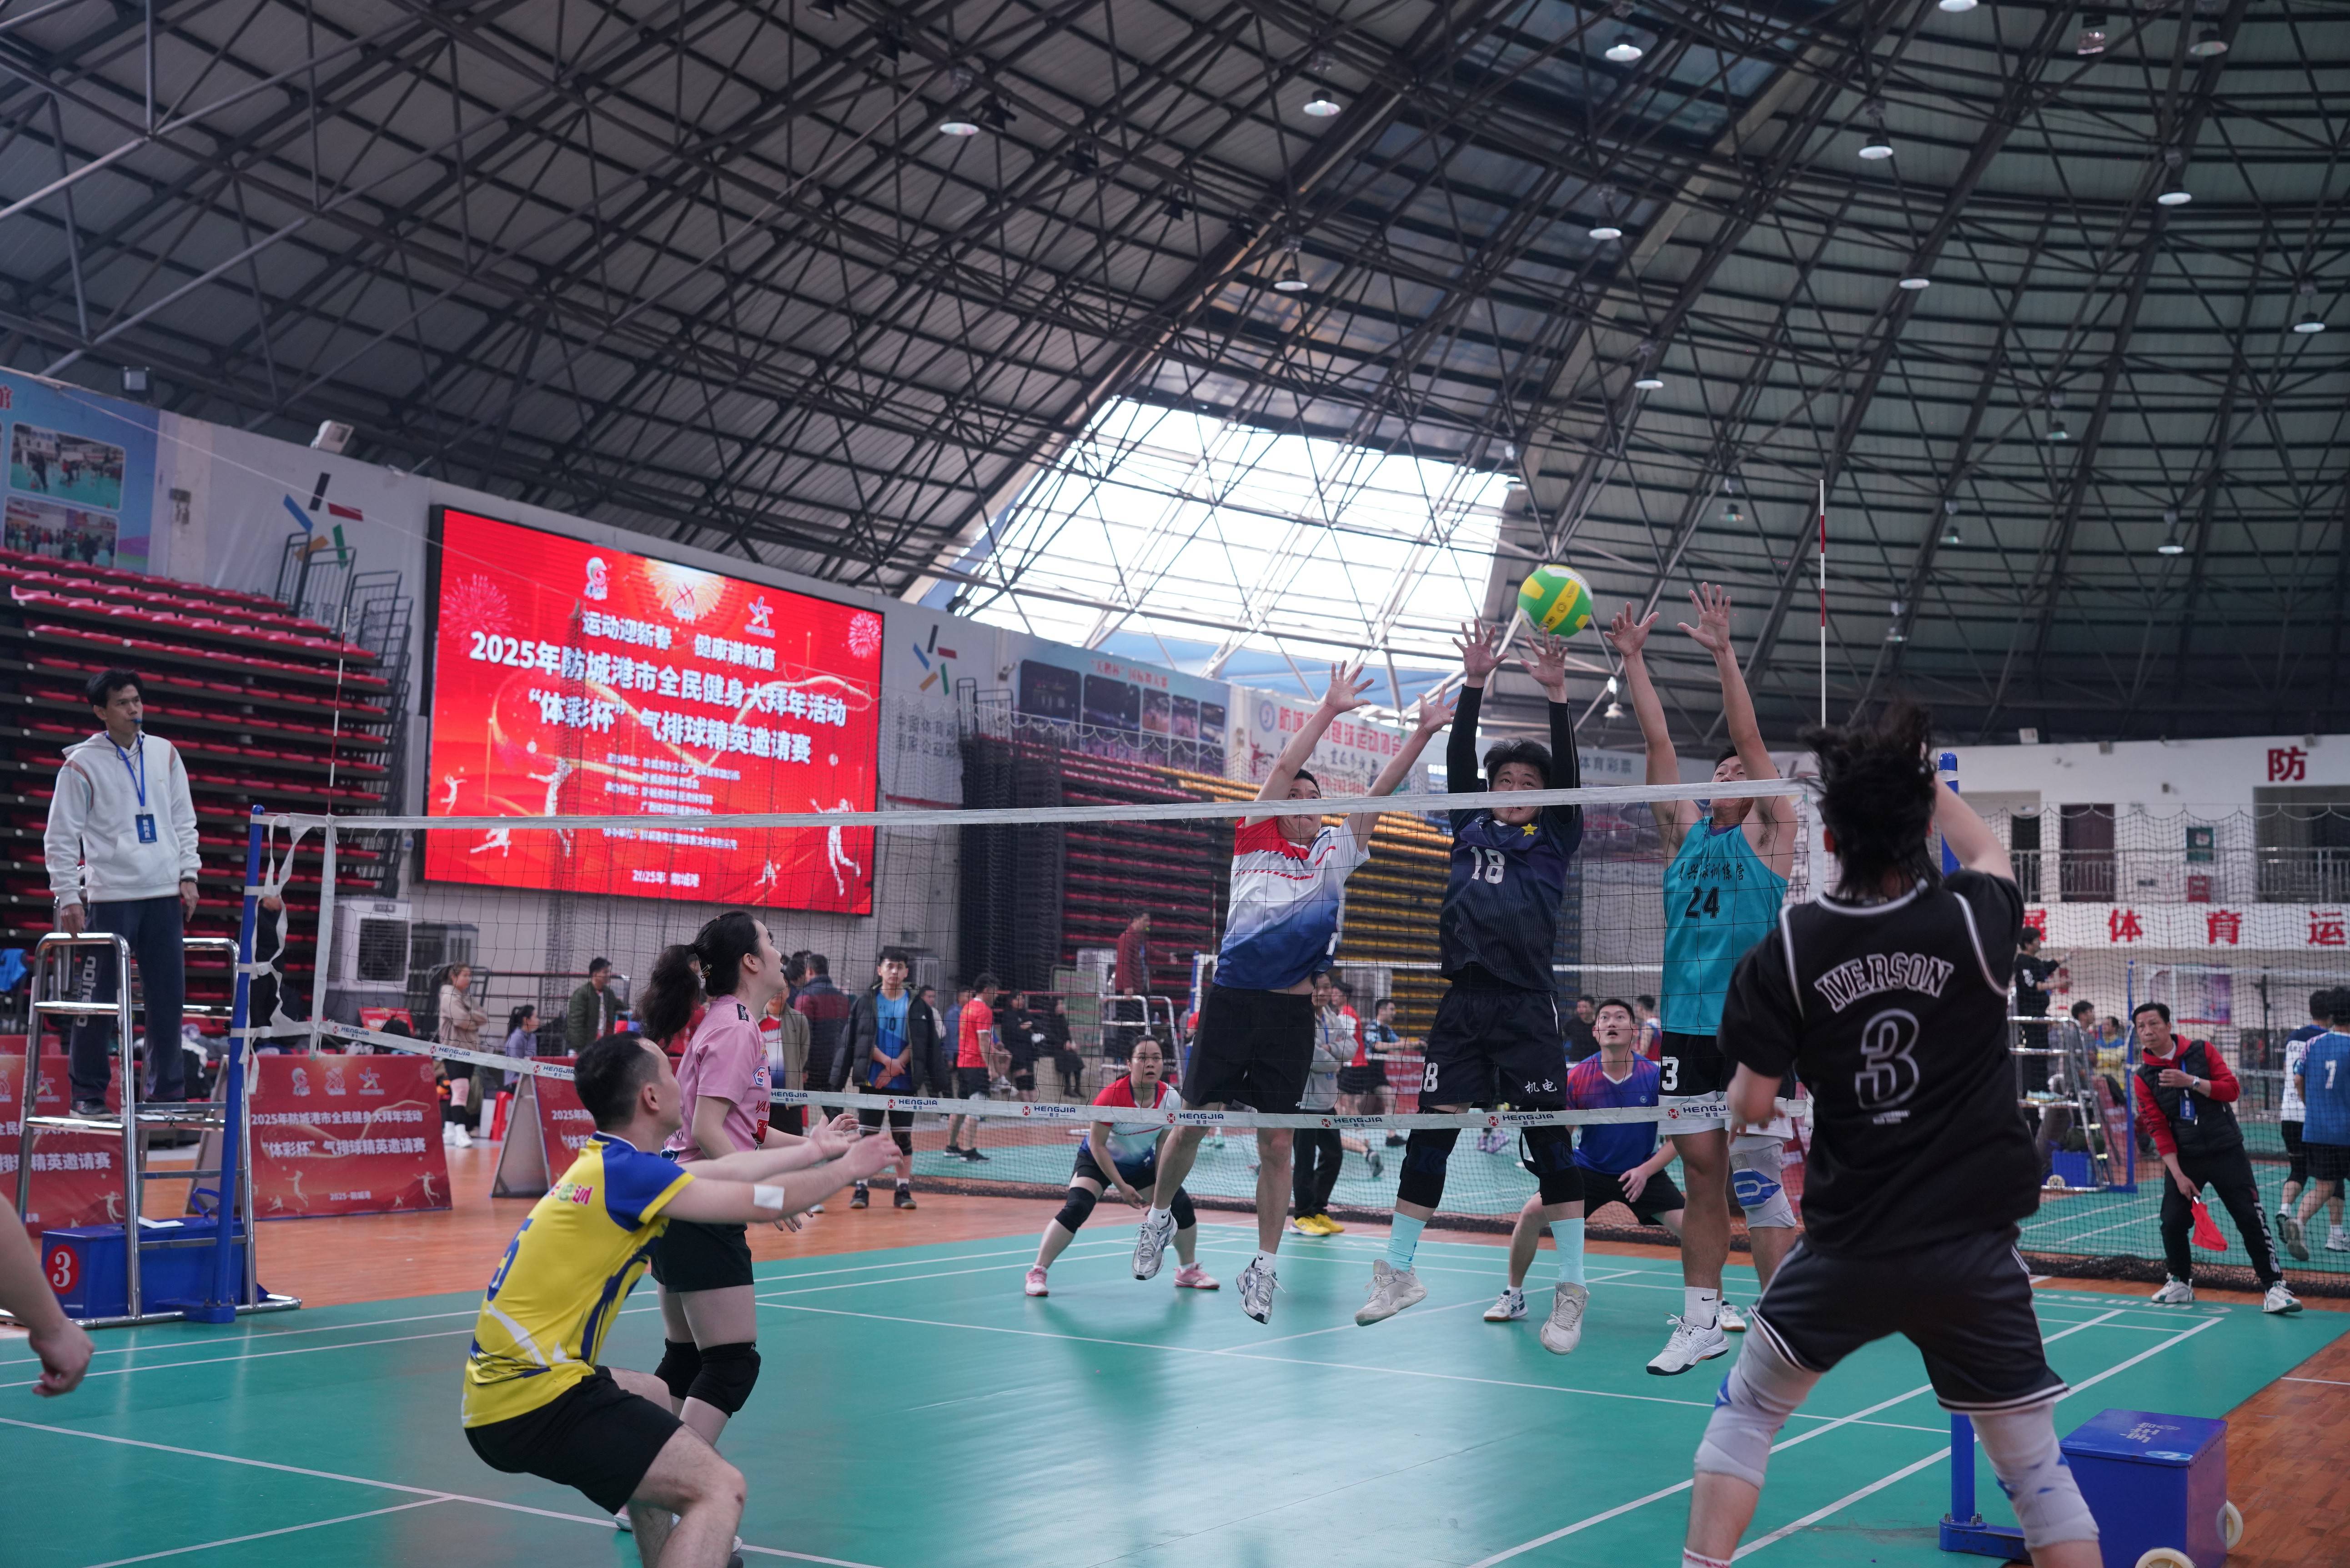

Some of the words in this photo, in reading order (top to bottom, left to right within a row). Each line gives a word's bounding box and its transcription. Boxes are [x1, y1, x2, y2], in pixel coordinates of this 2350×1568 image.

[582, 611, 672, 650] 运动迎新春
[469, 631, 847, 727] 2025年防城港市全民健身大拜年活动
[528, 689, 626, 733] “体彩杯”
[639, 707, 811, 764] 气排球精英邀请赛
[2267, 745, 2307, 781] 防
[1470, 846, 1505, 884] 18
[1684, 886, 1720, 919] 24
[1814, 952, 1954, 1014] IVERSON
[341, 1027, 369, 1035] HENGJIA
[438, 1046, 471, 1057] HENGJIA
[1855, 1008, 1920, 1110] 3
[1524, 1078, 1558, 1094] 机电
[2325, 1060, 2337, 1089] 7
[251, 1110, 423, 1126] 2025年防城港市全民健身大拜年活动
[263, 1141, 315, 1158] “体彩杯”
[323, 1137, 427, 1156] 气排球精英邀请赛
[53, 1251, 71, 1288] 3
